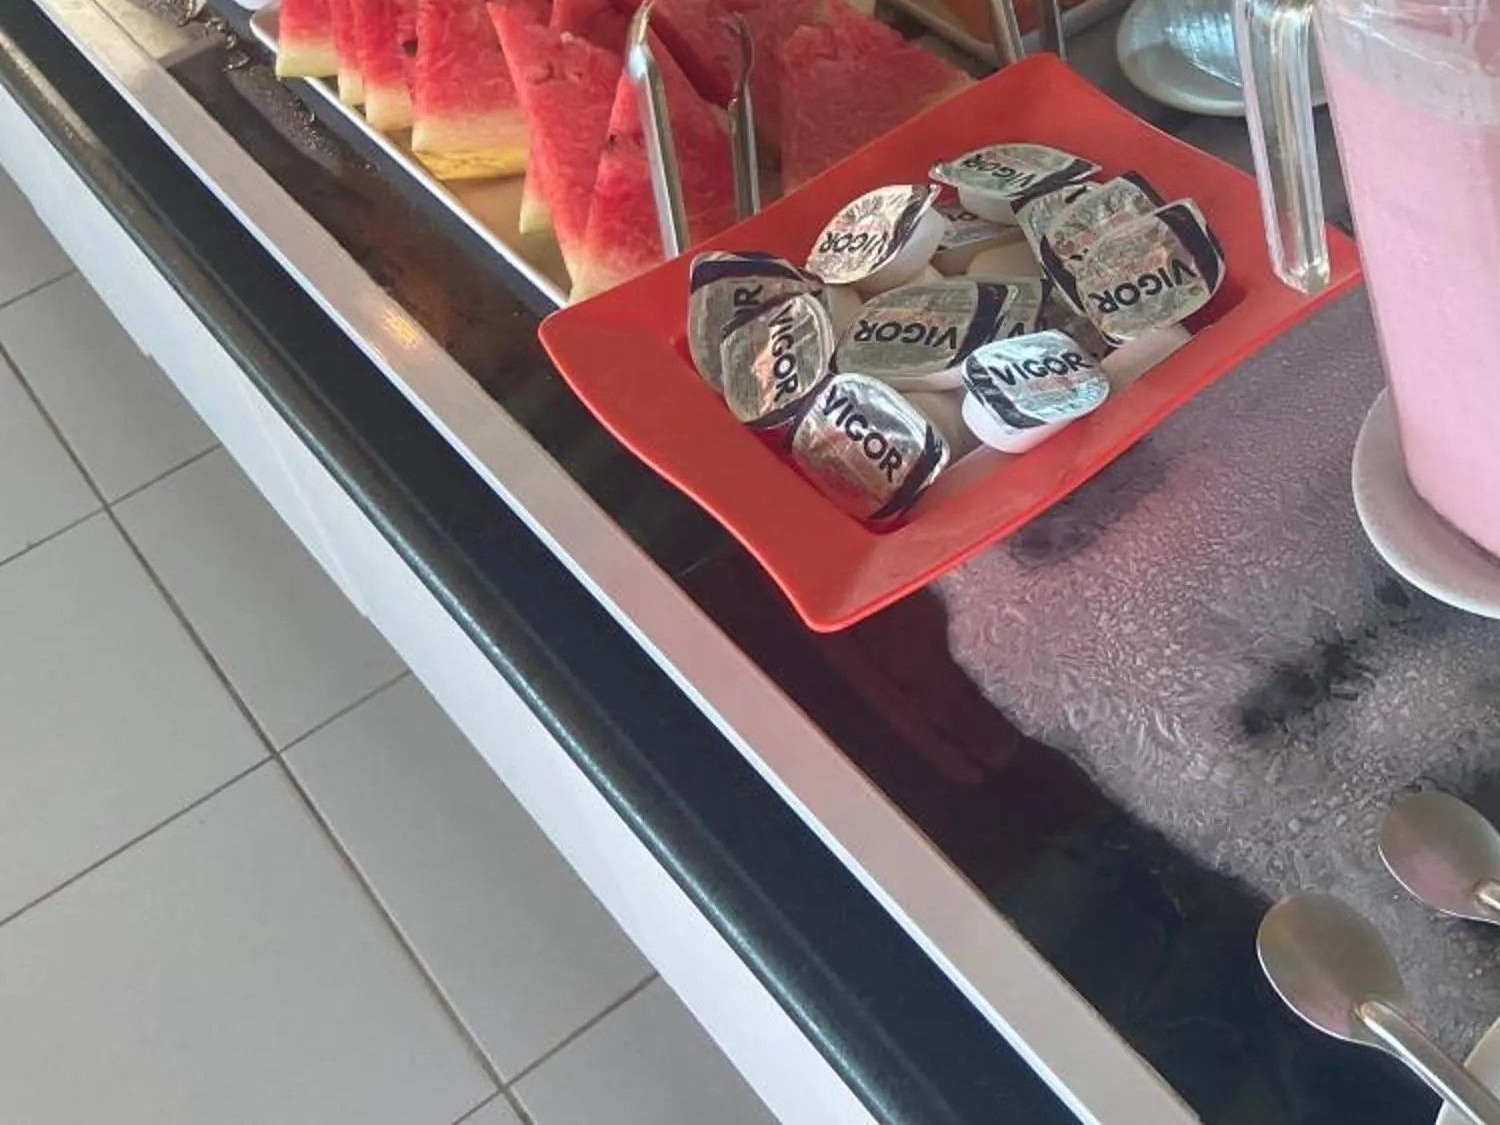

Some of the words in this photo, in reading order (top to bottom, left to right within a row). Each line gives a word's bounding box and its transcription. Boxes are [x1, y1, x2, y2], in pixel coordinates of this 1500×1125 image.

[819, 231, 888, 255] VIGOR
[1088, 259, 1196, 313] VIGOR
[768, 304, 798, 402] VIGOR
[854, 320, 957, 349] VIGOR
[988, 352, 1095, 385] VIGOR
[822, 385, 902, 483] VIGOR
